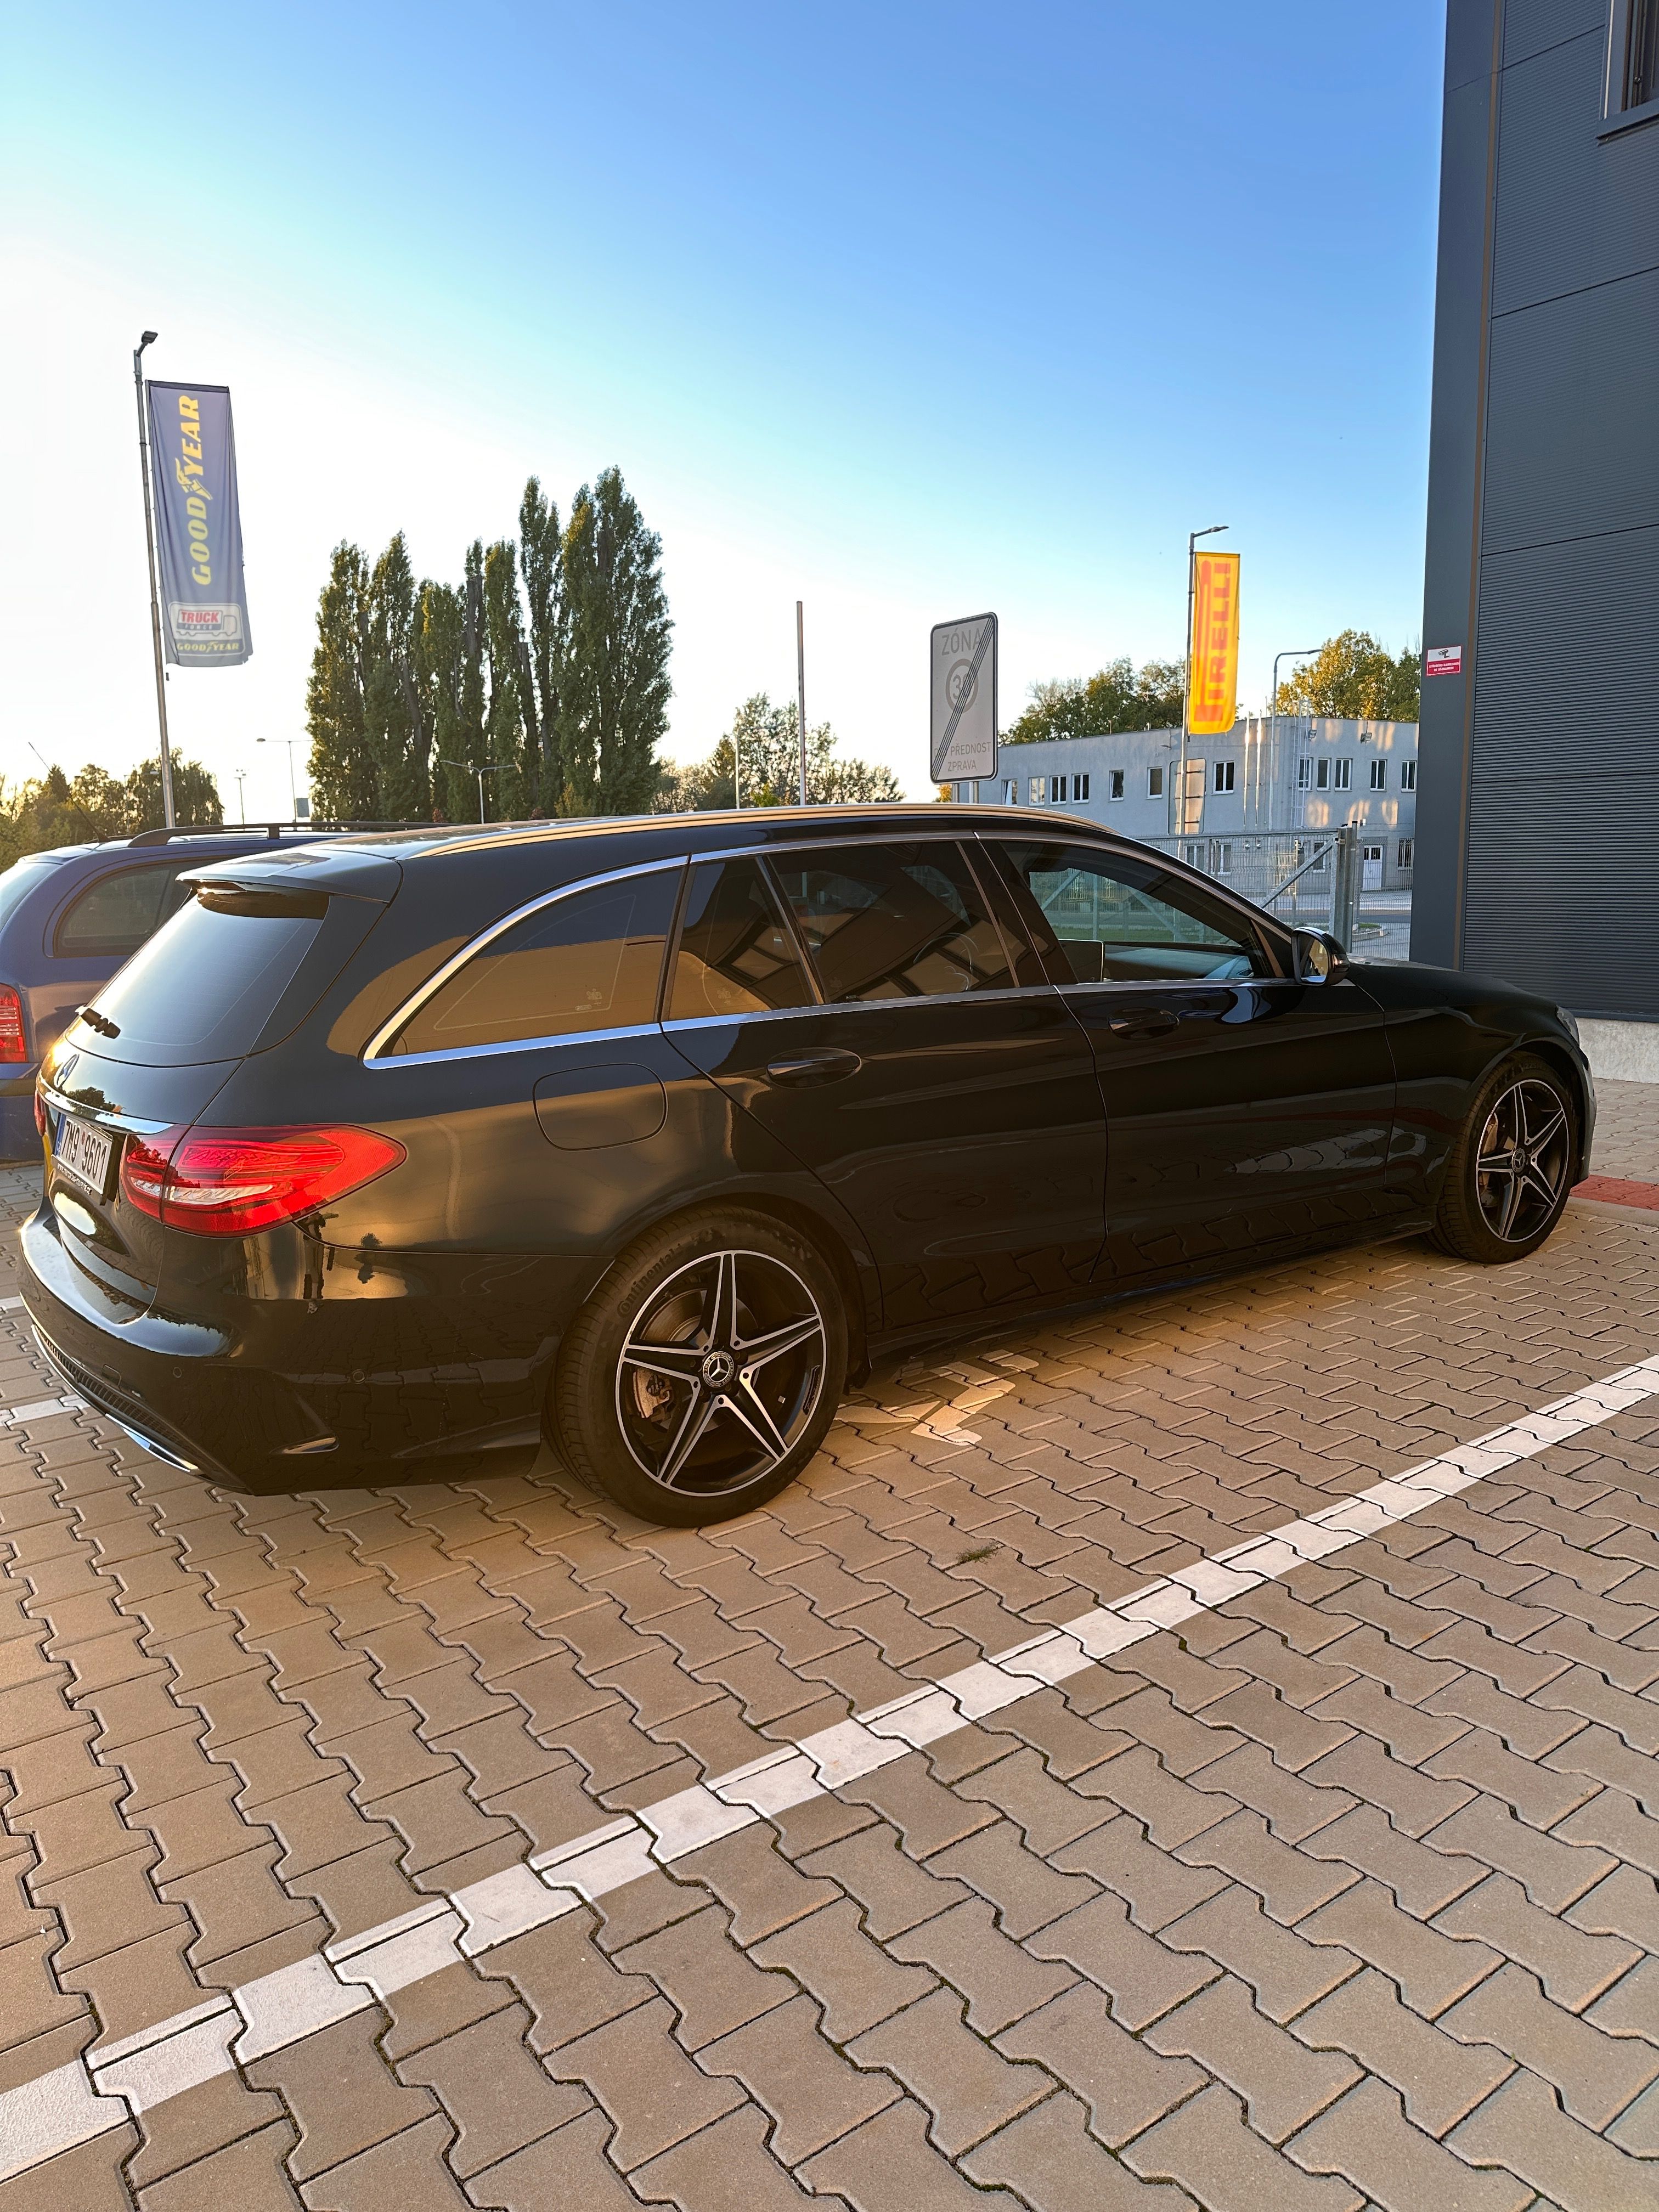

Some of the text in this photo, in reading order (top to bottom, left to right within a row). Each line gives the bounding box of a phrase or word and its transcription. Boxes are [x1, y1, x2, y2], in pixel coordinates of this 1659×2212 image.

[175, 395, 213, 585] GOODYEAR
[181, 611, 219, 623] TRUCK
[176, 641, 240, 653] GOODYEAR
[941, 627, 982, 656] ZÓNA
[1194, 560, 1231, 721] PIRELLI
[950, 742, 991, 757] PŘEDNOST
[947, 759, 977, 772] ZPRAVA
[61, 1122, 81, 1163] 7M9
[82, 1133, 108, 1184] 9601
[617, 1248, 675, 1317] Continental
